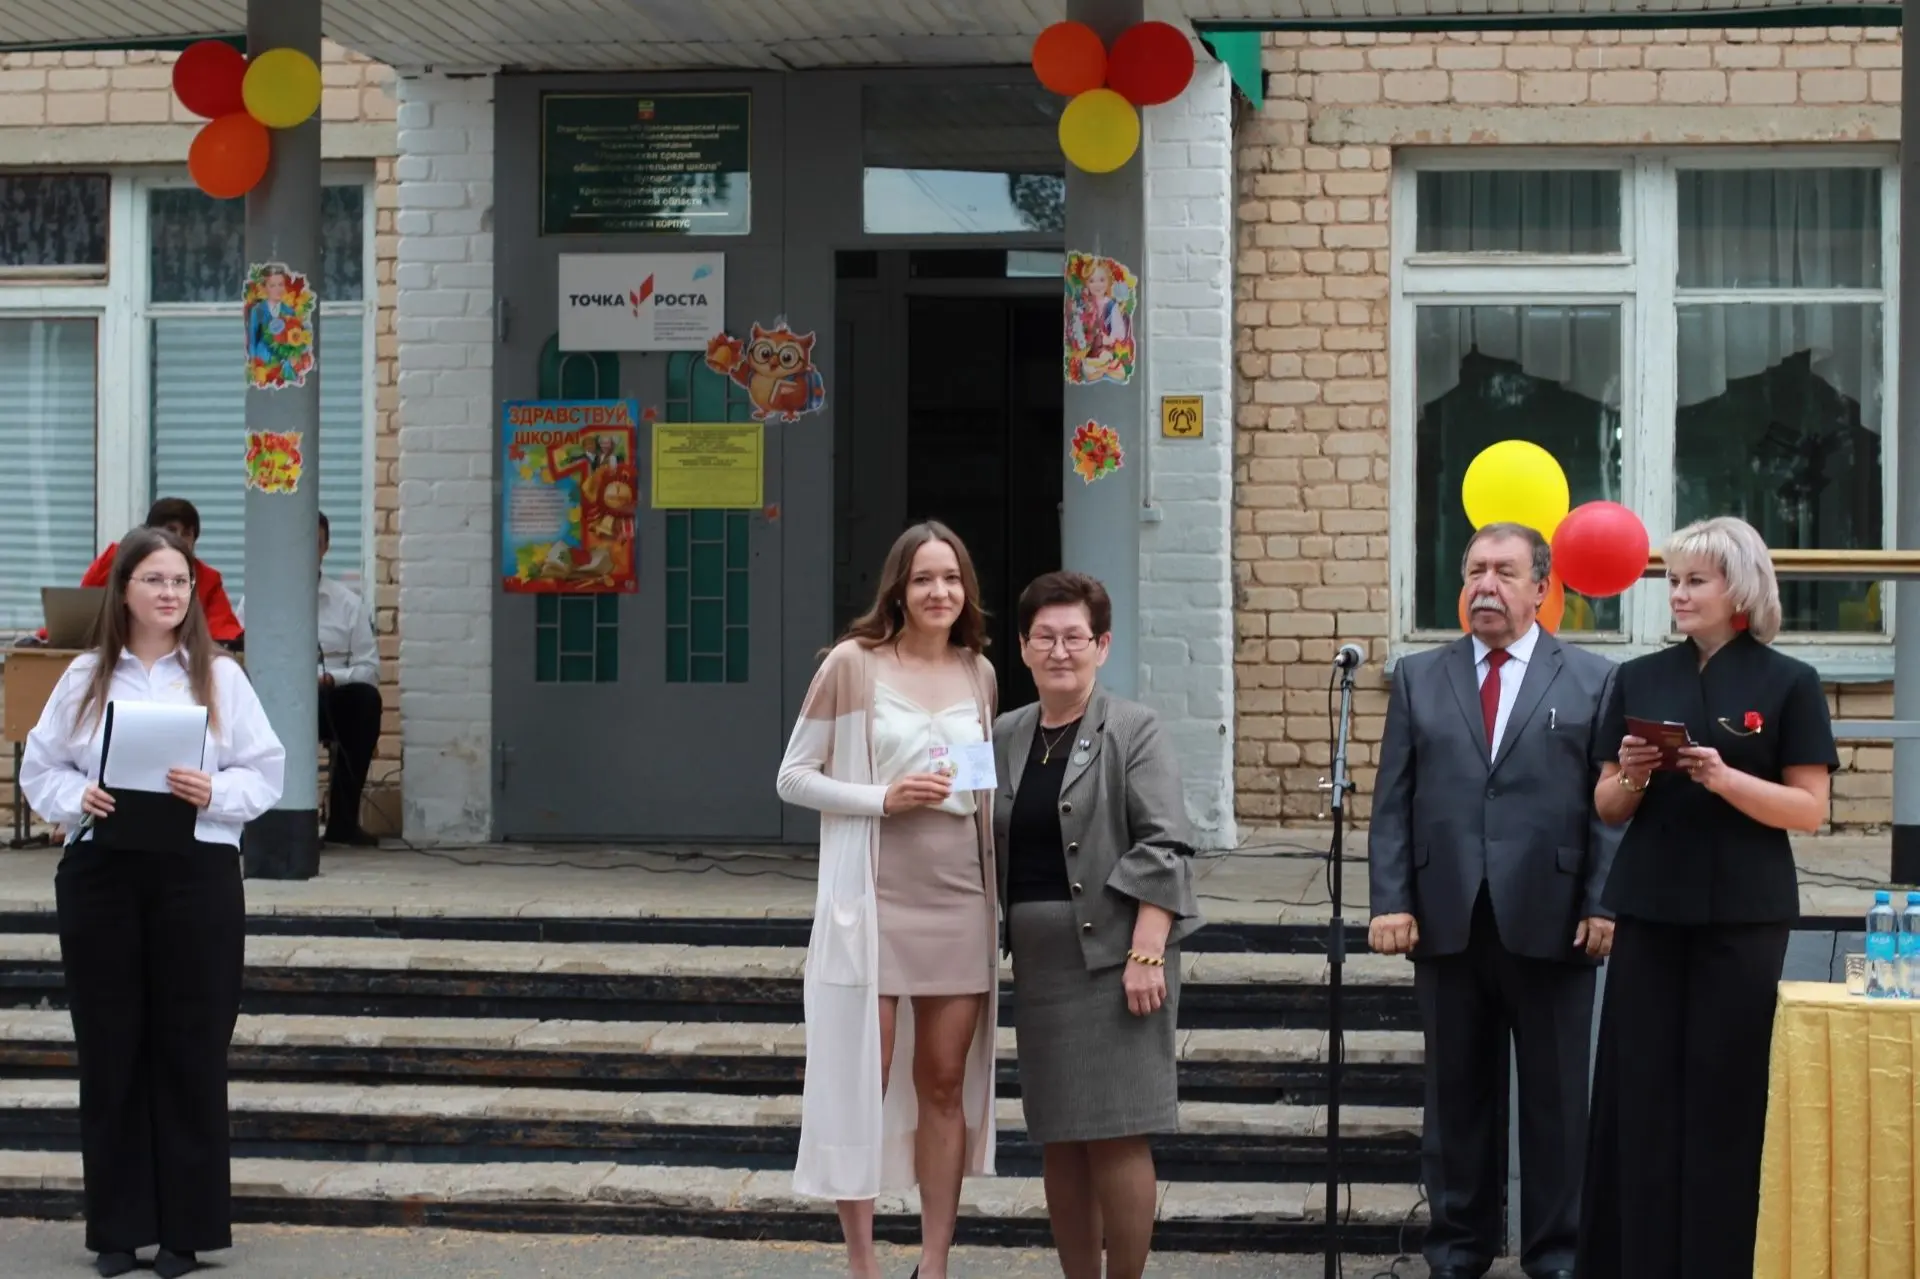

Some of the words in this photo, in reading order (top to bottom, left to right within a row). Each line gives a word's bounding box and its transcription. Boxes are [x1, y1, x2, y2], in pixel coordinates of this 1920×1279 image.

[655, 219, 691, 228] КОРПУС
[569, 294, 625, 307] ТОЧКА
[654, 294, 708, 307] РОСТА
[515, 431, 580, 445] ШКОЛА!
